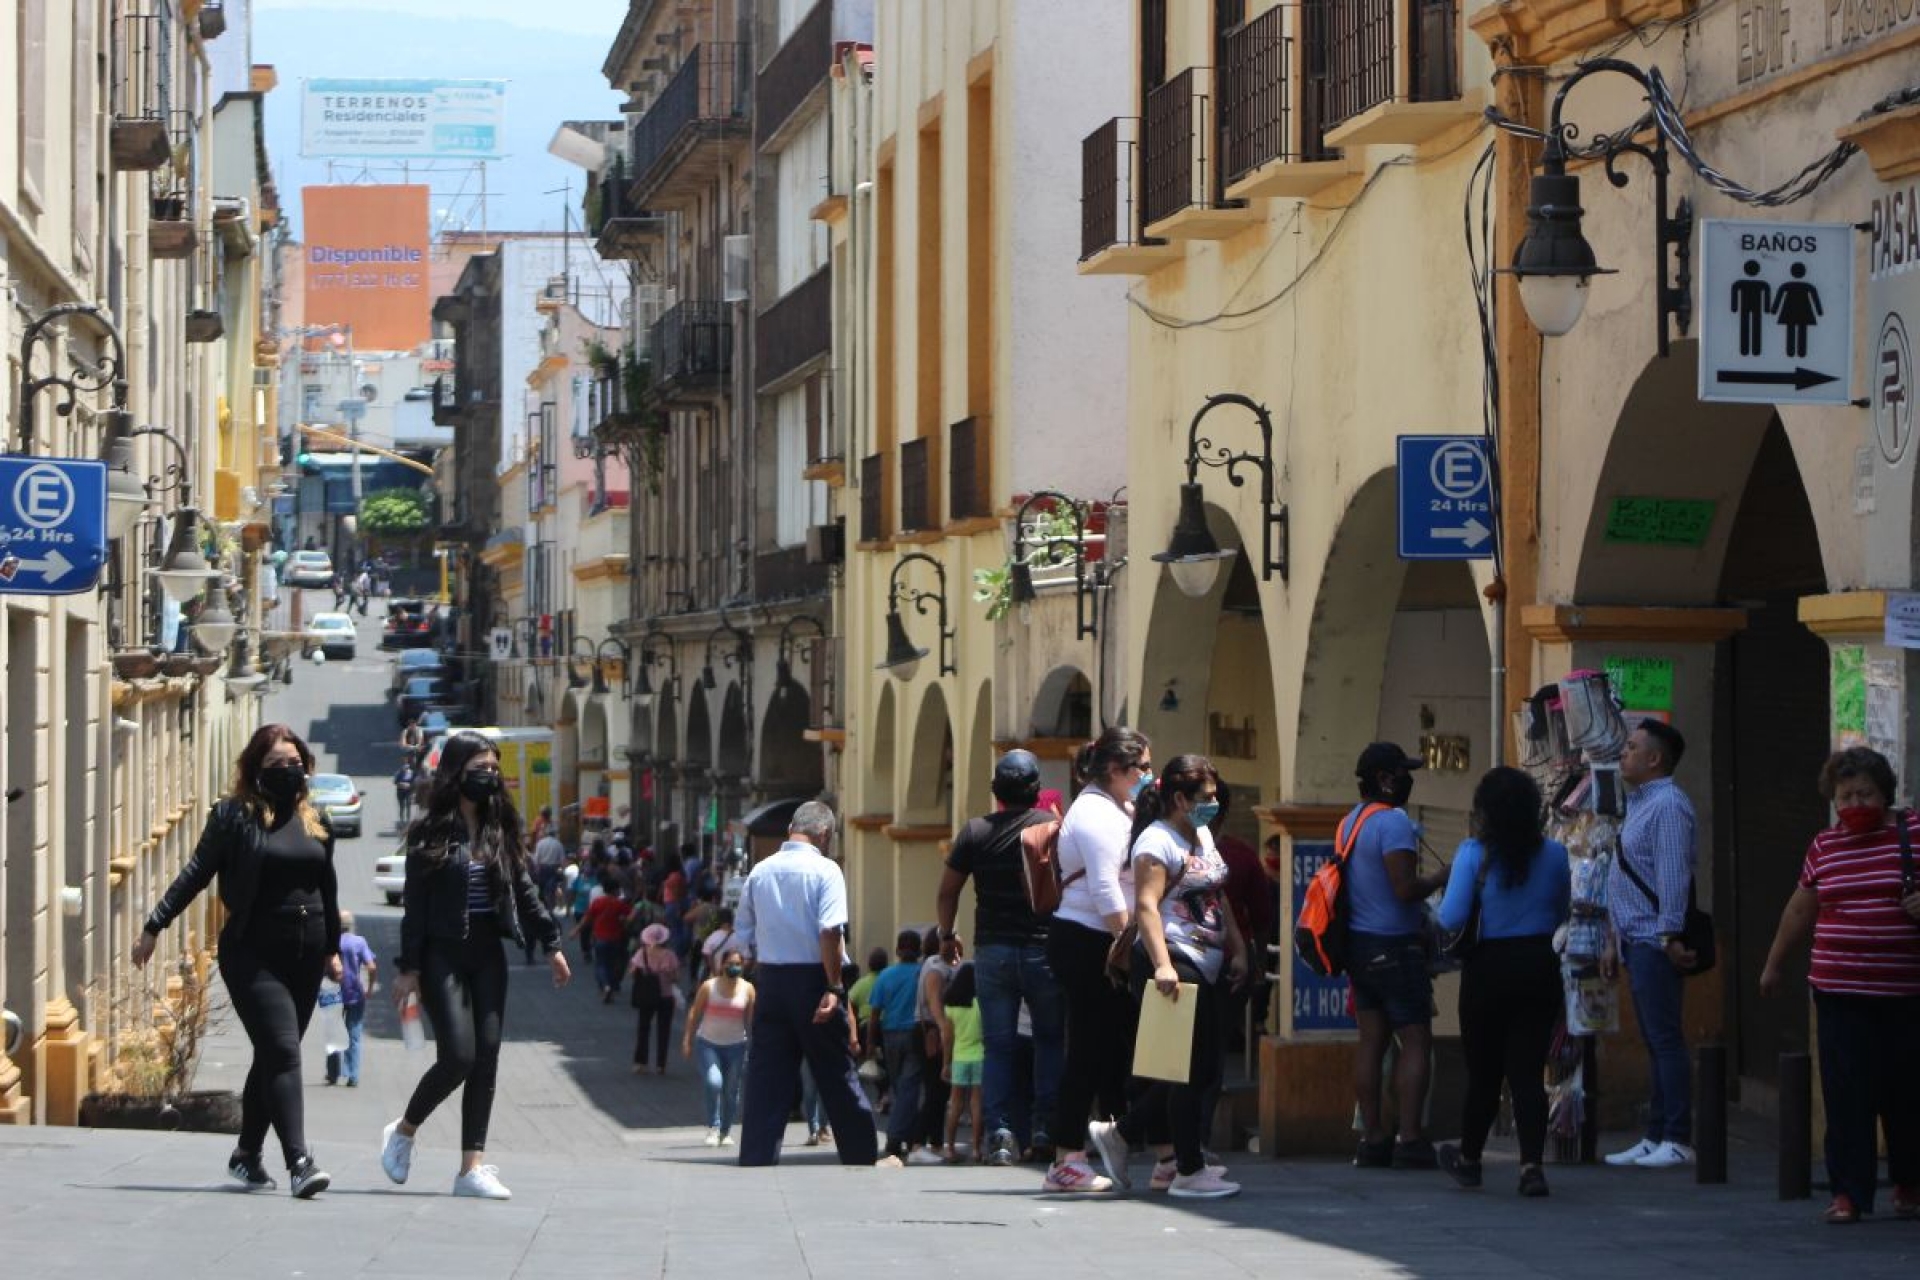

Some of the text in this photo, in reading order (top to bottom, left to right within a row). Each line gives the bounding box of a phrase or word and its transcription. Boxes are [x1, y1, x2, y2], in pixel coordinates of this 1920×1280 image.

[324, 96, 428, 109] TERRENOS
[324, 110, 427, 123] Residenciales
[1741, 231, 1817, 253] BAÑOS
[311, 244, 422, 267] Disponible
[1444, 450, 1475, 488] E
[29, 474, 60, 517] E
[1430, 499, 1488, 512] 24 Hrs
[12, 527, 75, 544] 24 Hrs
[1294, 985, 1311, 1017] 24
